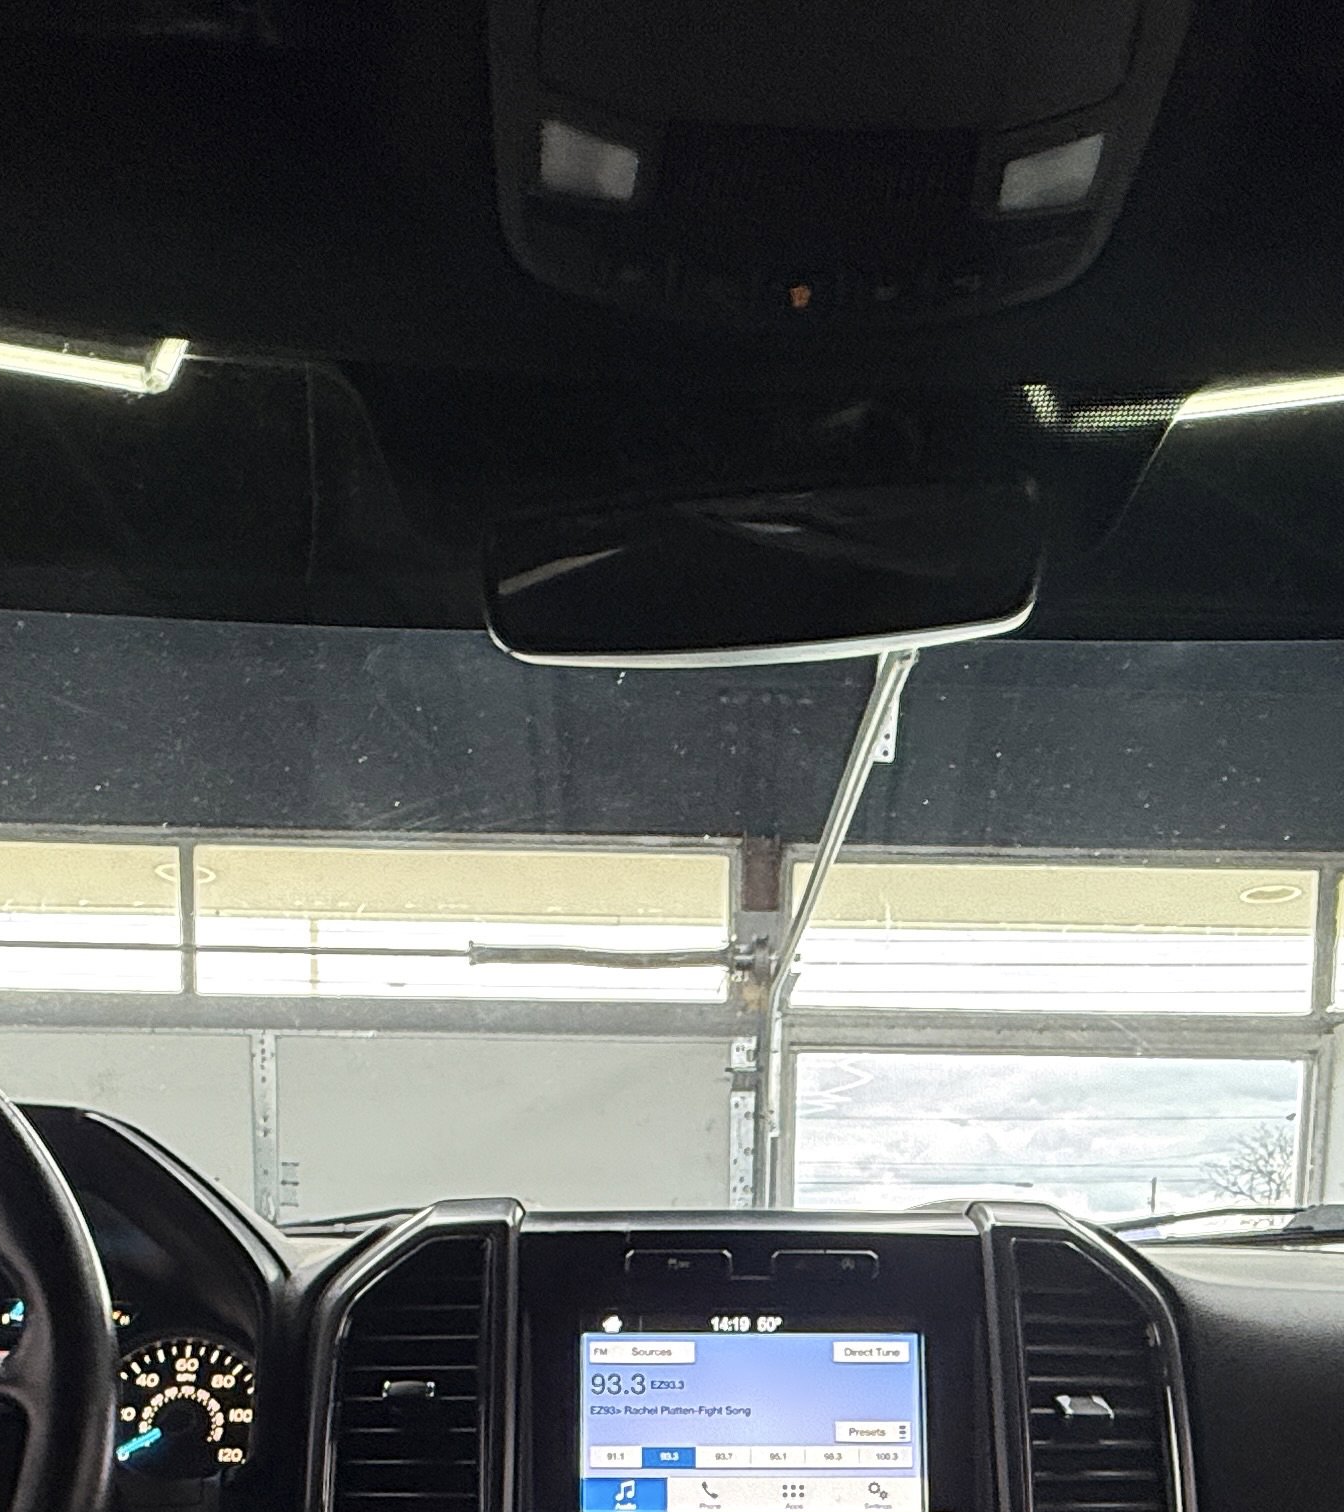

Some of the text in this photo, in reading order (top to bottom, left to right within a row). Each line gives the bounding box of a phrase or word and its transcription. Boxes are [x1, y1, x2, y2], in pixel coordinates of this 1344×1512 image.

[710, 1315, 752, 1332] 14:19
[593, 1347, 673, 1357] FM Sources
[844, 1347, 901, 1357] Direct Tune
[175, 1358, 199, 1372] 60
[136, 1373, 159, 1388] 40
[591, 1373, 646, 1395] 93.3
[650, 1380, 685, 1390] EZ93.3
[120, 1406, 136, 1421] 0
[229, 1408, 253, 1423] 100
[624, 1406, 658, 1415] Rachel
[725, 1406, 752, 1417] Song
[848, 1427, 886, 1437] Presets
[218, 1448, 243, 1463] 120
[715, 1453, 733, 1461] 93.7
